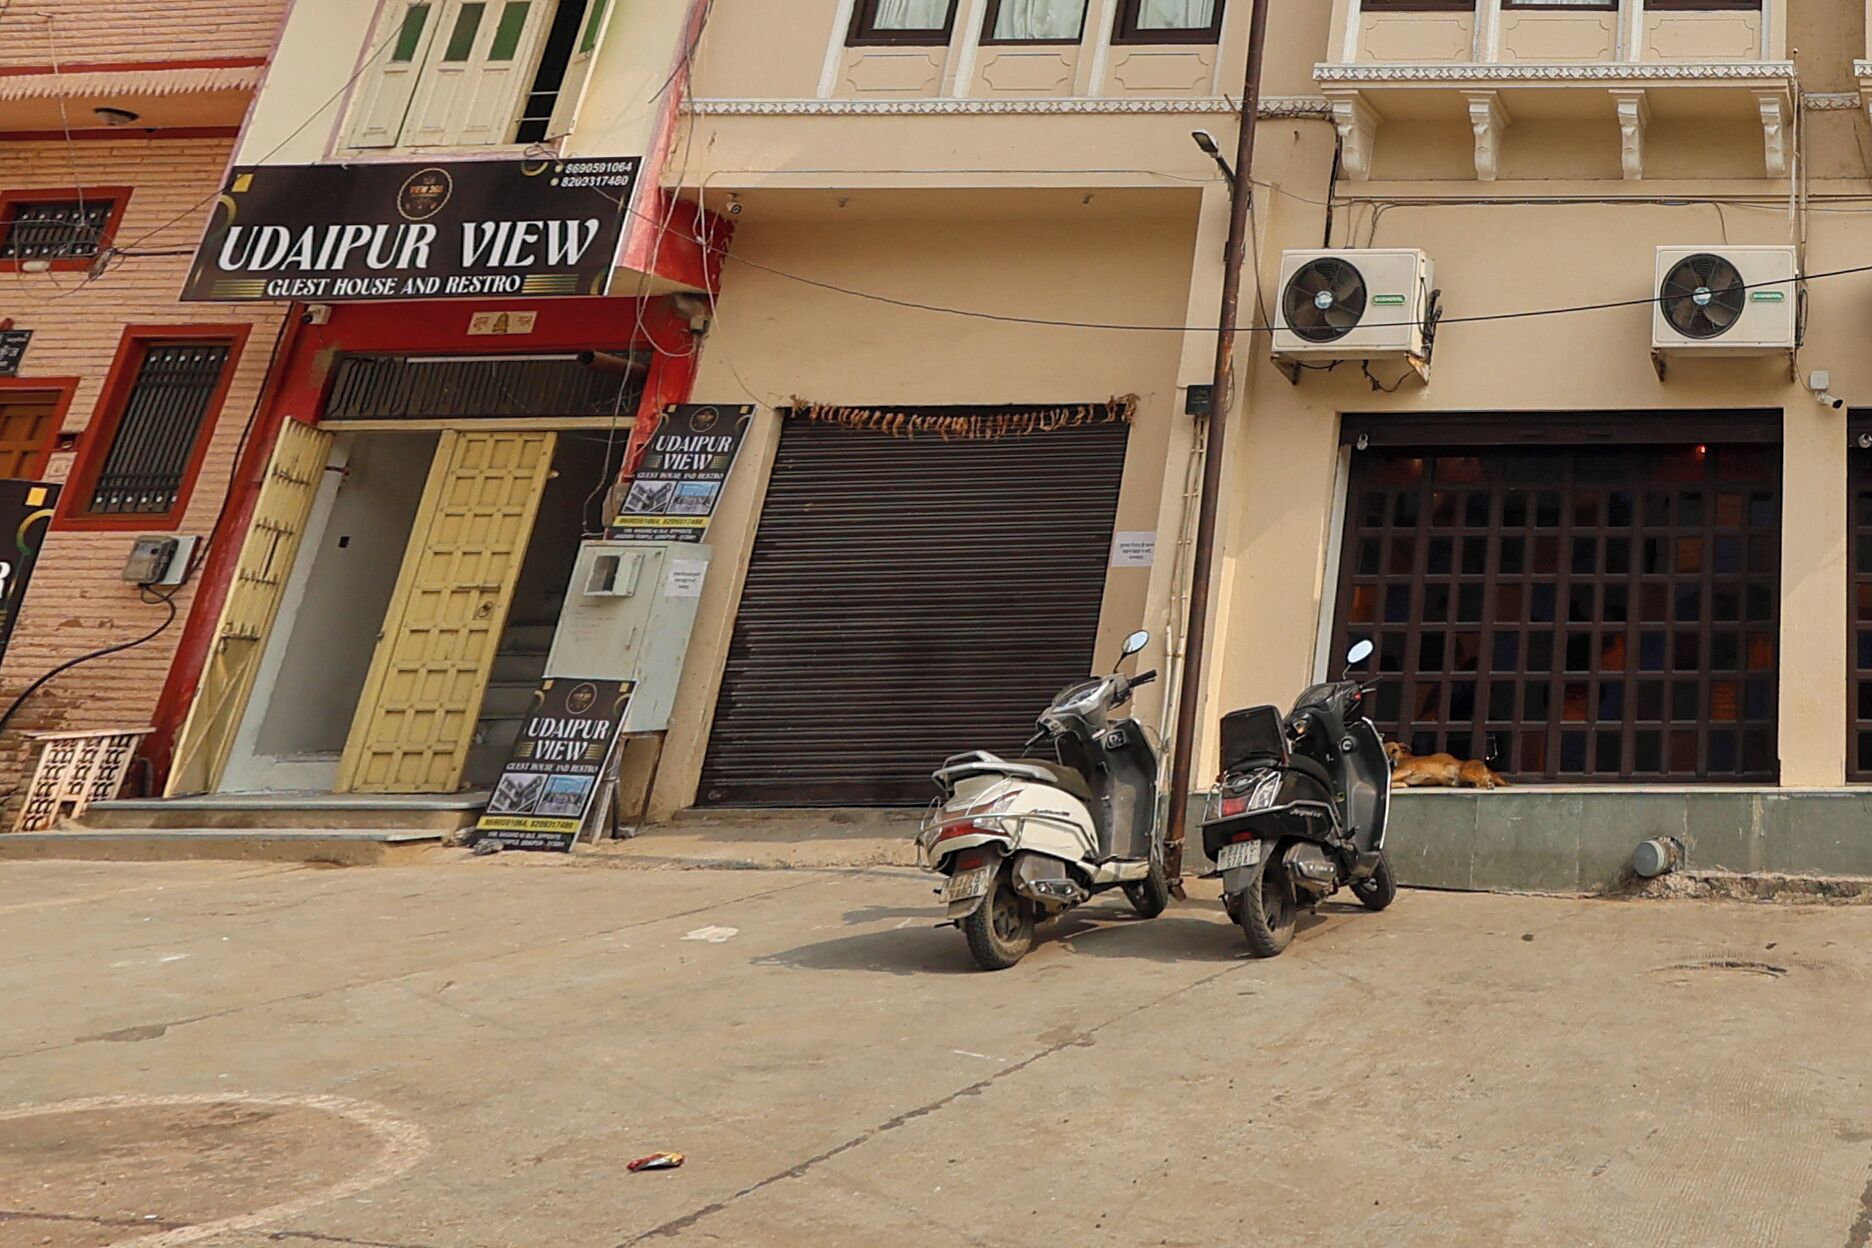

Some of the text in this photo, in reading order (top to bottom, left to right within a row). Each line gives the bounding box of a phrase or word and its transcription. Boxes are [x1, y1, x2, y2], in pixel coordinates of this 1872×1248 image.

[218, 218, 600, 271] UDAIPUR VIEW
[267, 274, 521, 296] GUEST HOUSE AND RESTRO
[655, 435, 732, 452] UDAIPUR
[663, 453, 713, 470] VIEW
[528, 717, 610, 740] UDAIPUR
[534, 739, 589, 761] VIEW
